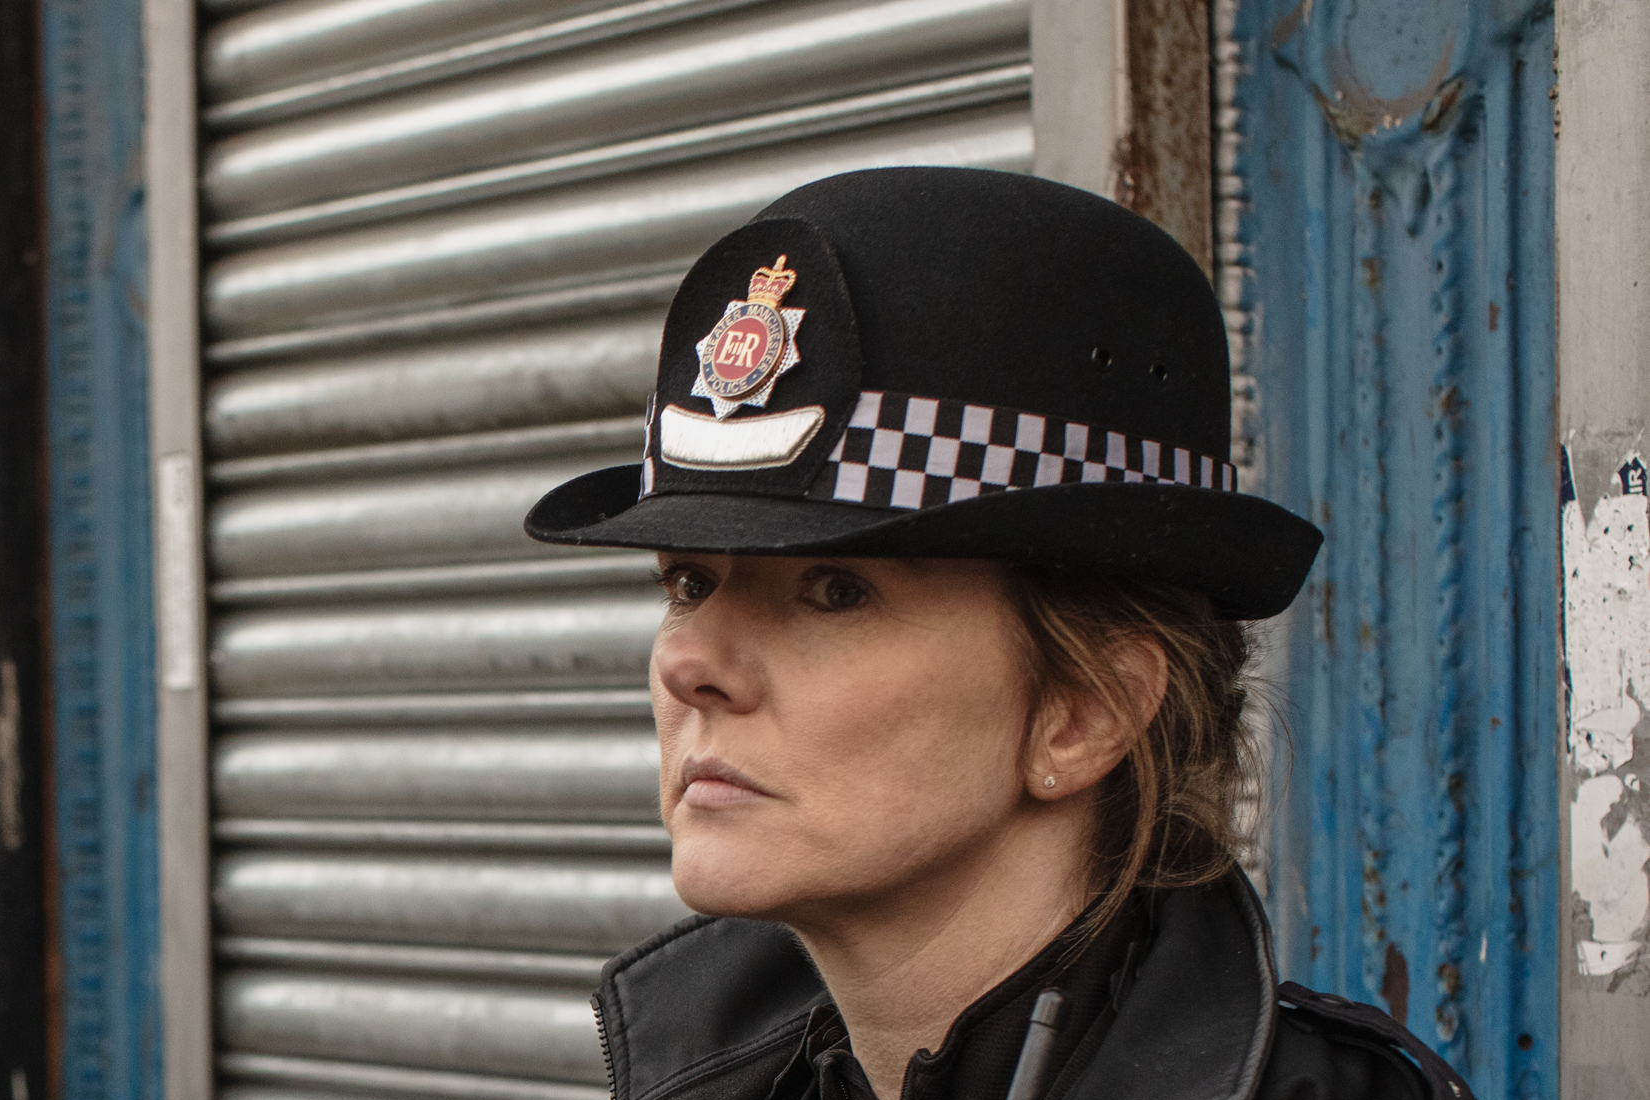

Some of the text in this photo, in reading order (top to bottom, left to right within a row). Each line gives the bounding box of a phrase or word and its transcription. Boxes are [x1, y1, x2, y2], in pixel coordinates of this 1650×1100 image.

[703, 305, 781, 372] GREATER MANCHESTER
[707, 375, 748, 393] POLICE
